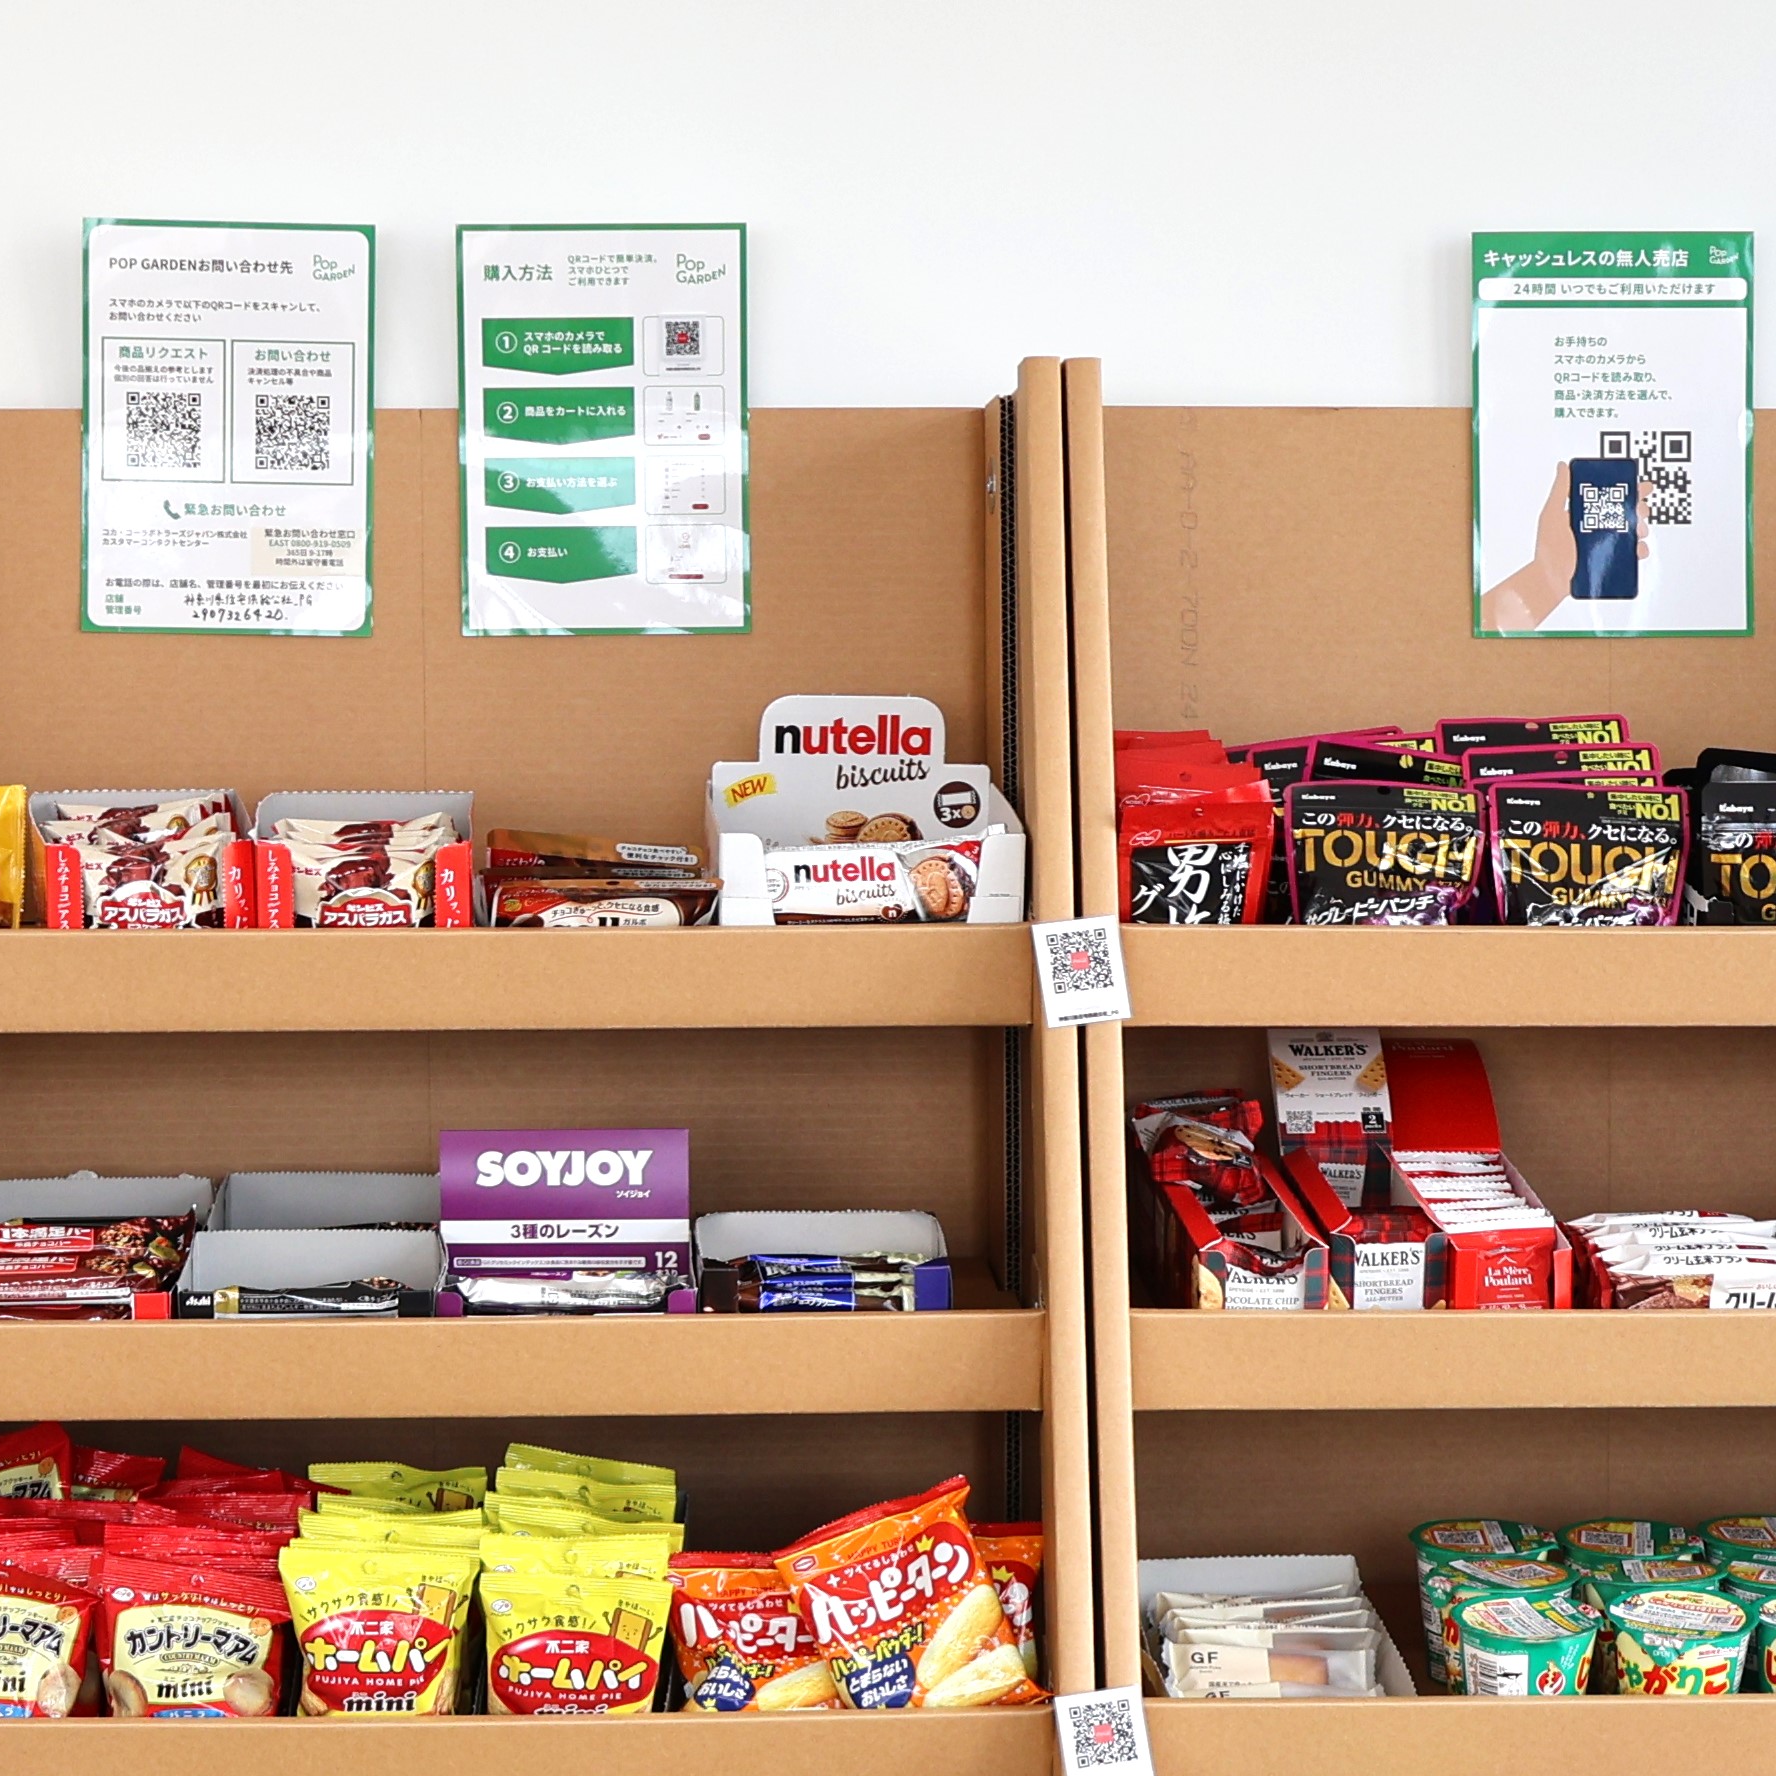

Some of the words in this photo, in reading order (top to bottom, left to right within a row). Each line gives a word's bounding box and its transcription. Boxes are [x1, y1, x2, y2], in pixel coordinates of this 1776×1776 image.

[109, 257, 138, 270] POP
[141, 258, 293, 275] GARDENお問い合わせ先
[1484, 250, 1689, 267] キャッシュレスの無人売店
[484, 264, 553, 281] 購入方法
[568, 266, 629, 275] スマホひとつで
[568, 277, 630, 286] ご利用できます
[1513, 283, 1556, 295] 24時間
[1561, 283, 1716, 296] いつでもご利用いただけます
[109, 311, 201, 323] お問い合わせください
[524, 330, 605, 342] スマホのカメラで
[1554, 336, 1607, 348] お手持ちの
[119, 346, 208, 360] 商品リクエスト
[255, 349, 331, 362] お問い合わせ
[1554, 354, 1646, 365] スマホのカメラから
[1554, 372, 1658, 384] QRコードを読み取り、
[525, 405, 626, 417] 商品をカートに入れる
[1554, 407, 1621, 419] 購入できます。
[184, 503, 286, 517] 緊急お問い合わせ
[264, 529, 355, 539] 緊急お問い合わせ窓口
[527, 547, 568, 558] お支払い
[105, 605, 142, 615] 管理番号
[775, 714, 932, 756] nutella
[836, 759, 927, 790] biscuits
[730, 778, 767, 801] NEW
[1302, 812, 1473, 832] この弾力、クセになる。
[1508, 820, 1677, 844] この弾力、クセになる。
[1293, 828, 1476, 882] TOUGH
[794, 856, 896, 883] nutella
[1346, 871, 1426, 891] GUMMY
[836, 884, 896, 905] biscuits
[104, 907, 186, 922] アスパラガス
[324, 911, 407, 926] アスパラガス
[1289, 1043, 1368, 1057] WALKER'S
[475, 1150, 653, 1188] SOYJOY
[510, 1222, 620, 1240] 3種のレーズン
[655, 1251, 678, 1269] 12
[1664, 1255, 1742, 1265] クリーム玄米ブラン
[1484, 1274, 1533, 1286] Poulard
[1364, 1287, 1403, 1295] FINGERS
[813, 1544, 969, 1644] ハッピーターン
[351, 1622, 393, 1636] 不二家
[126, 1626, 258, 1665] カントリーマアム
[546, 1640, 589, 1653] 不二家
[498, 1655, 644, 1689] ホームパイ
[848, 1658, 908, 1693] とまらない
[157, 1676, 212, 1698] mini
[861, 1675, 908, 1707] おいしさ
[343, 1692, 415, 1713] mini
